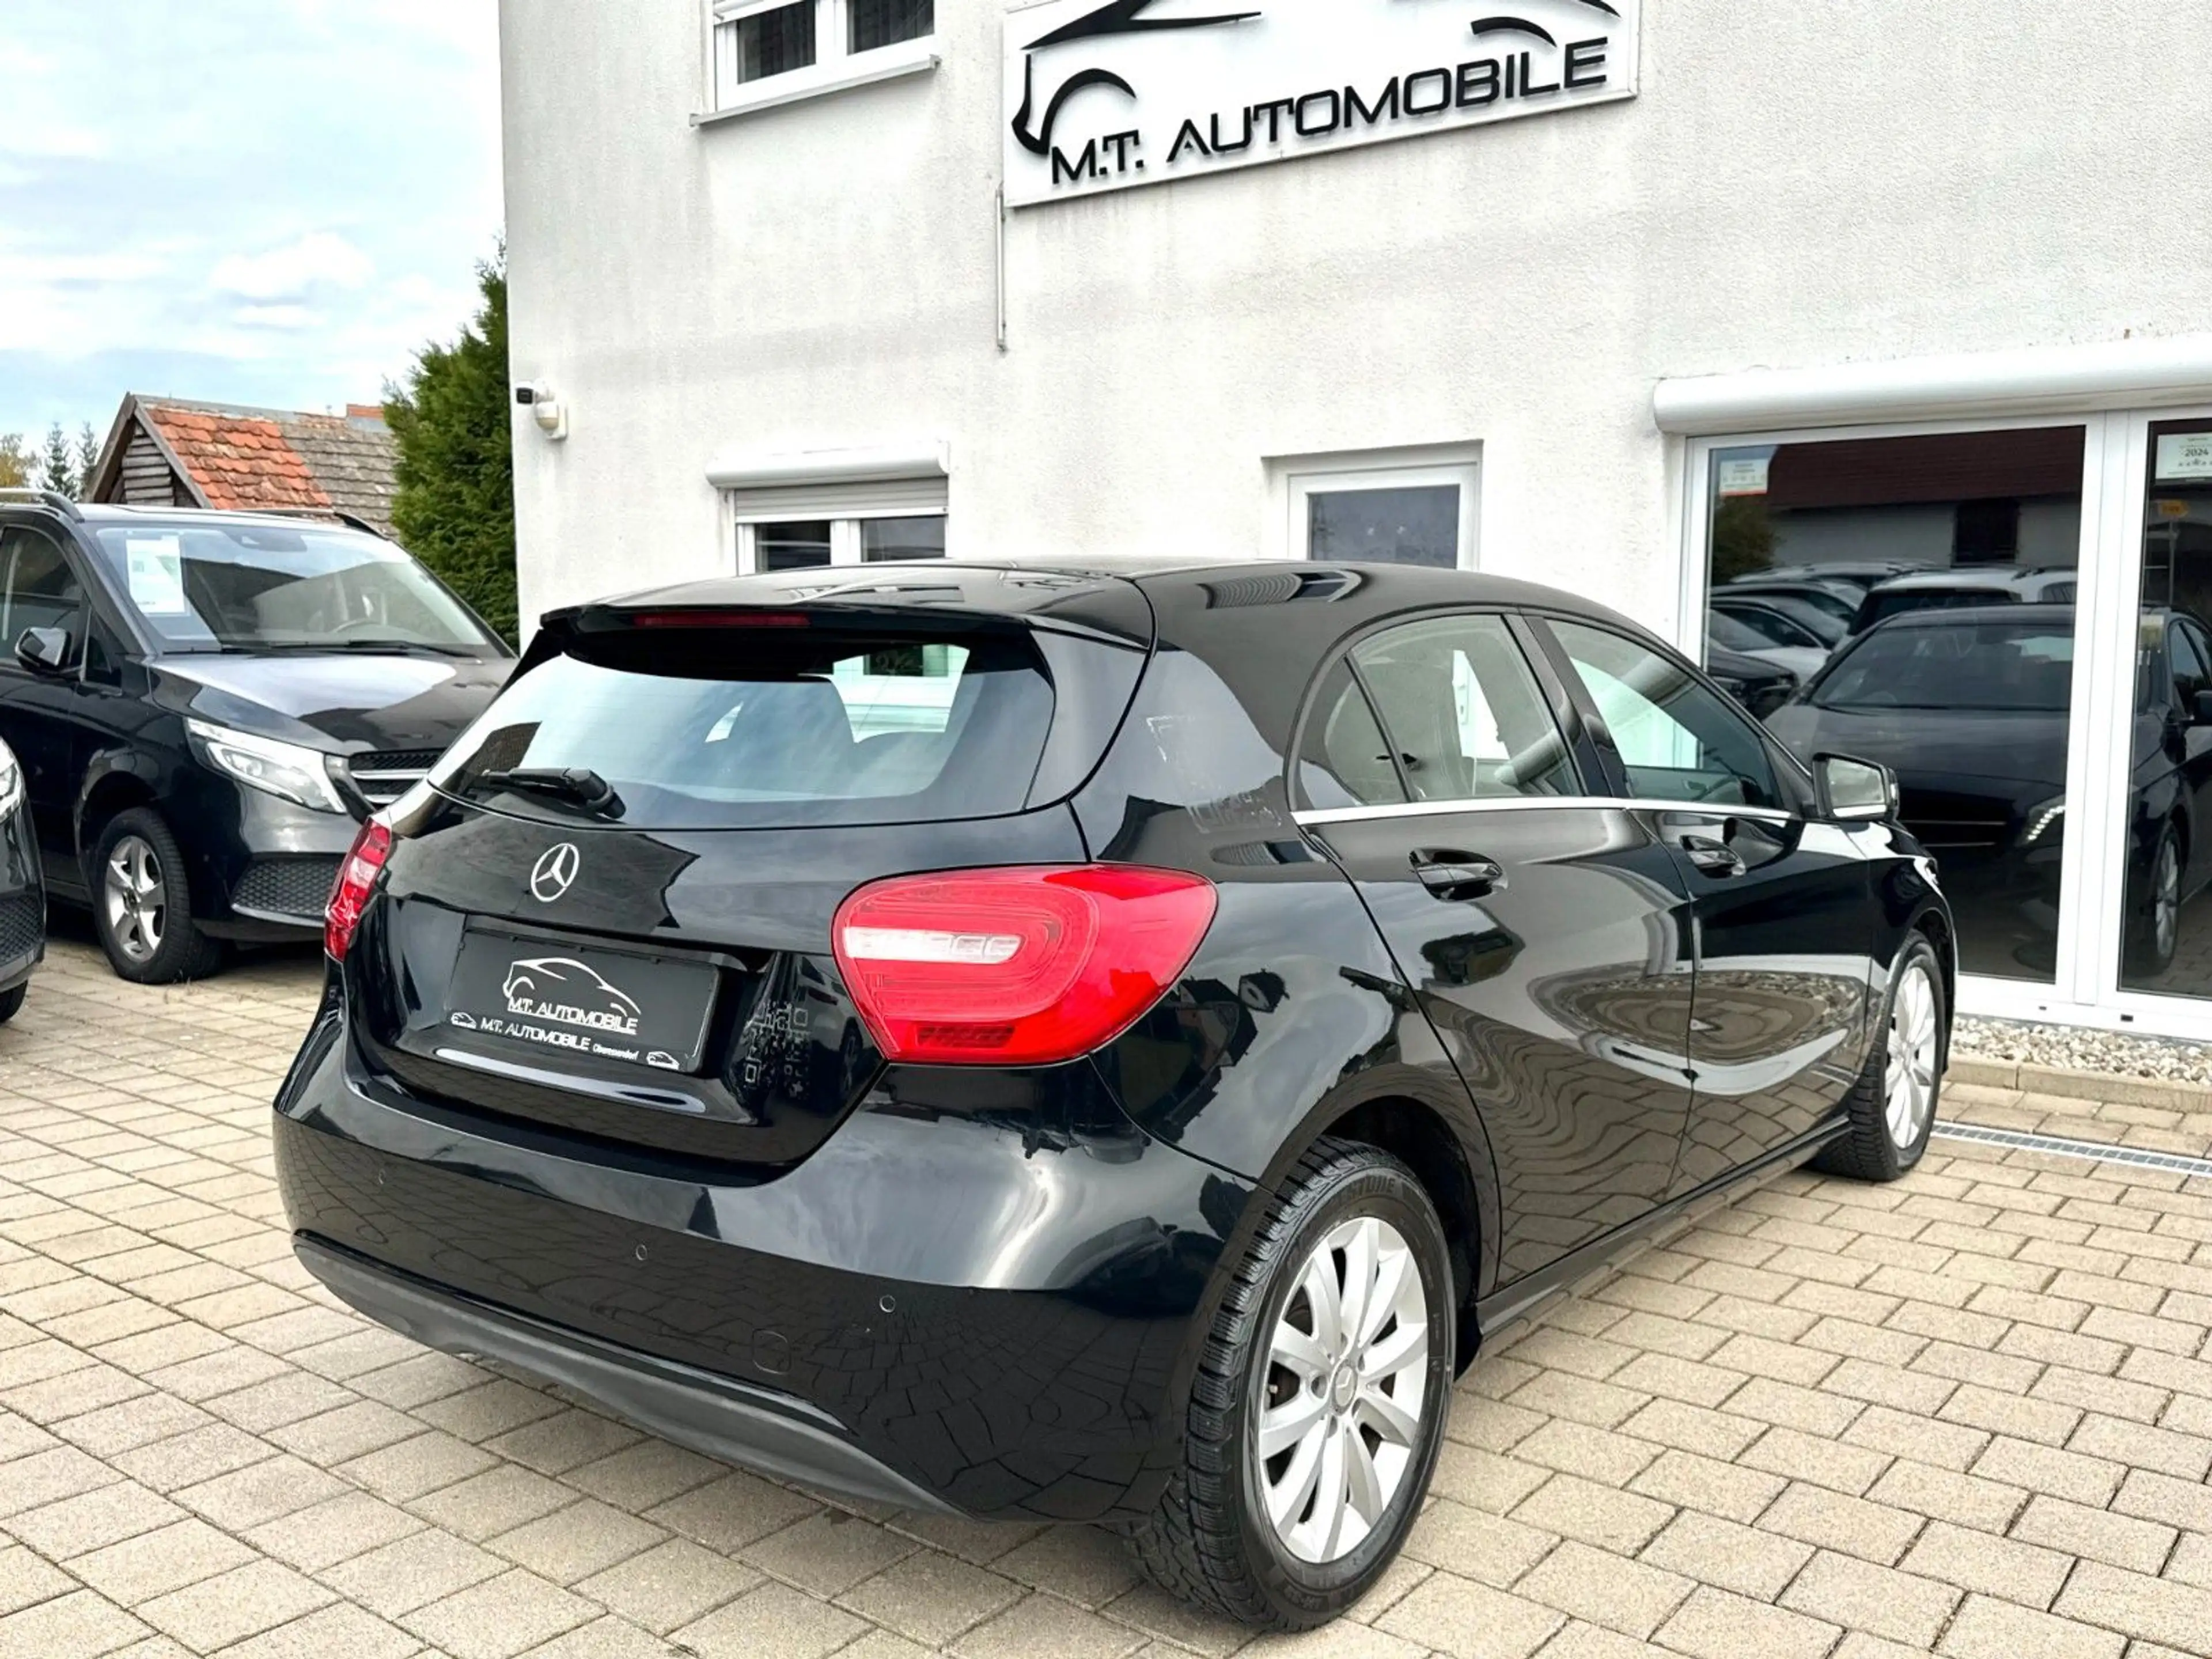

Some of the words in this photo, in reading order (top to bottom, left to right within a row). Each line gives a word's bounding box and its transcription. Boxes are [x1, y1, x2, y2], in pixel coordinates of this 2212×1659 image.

[1052, 129, 1144, 184] M.T.
[1166, 36, 1608, 163] AUTOMOBILE
[536, 1002, 638, 1032] AUTOMOBILE
[505, 1022, 591, 1052] AUTOMOBILE
